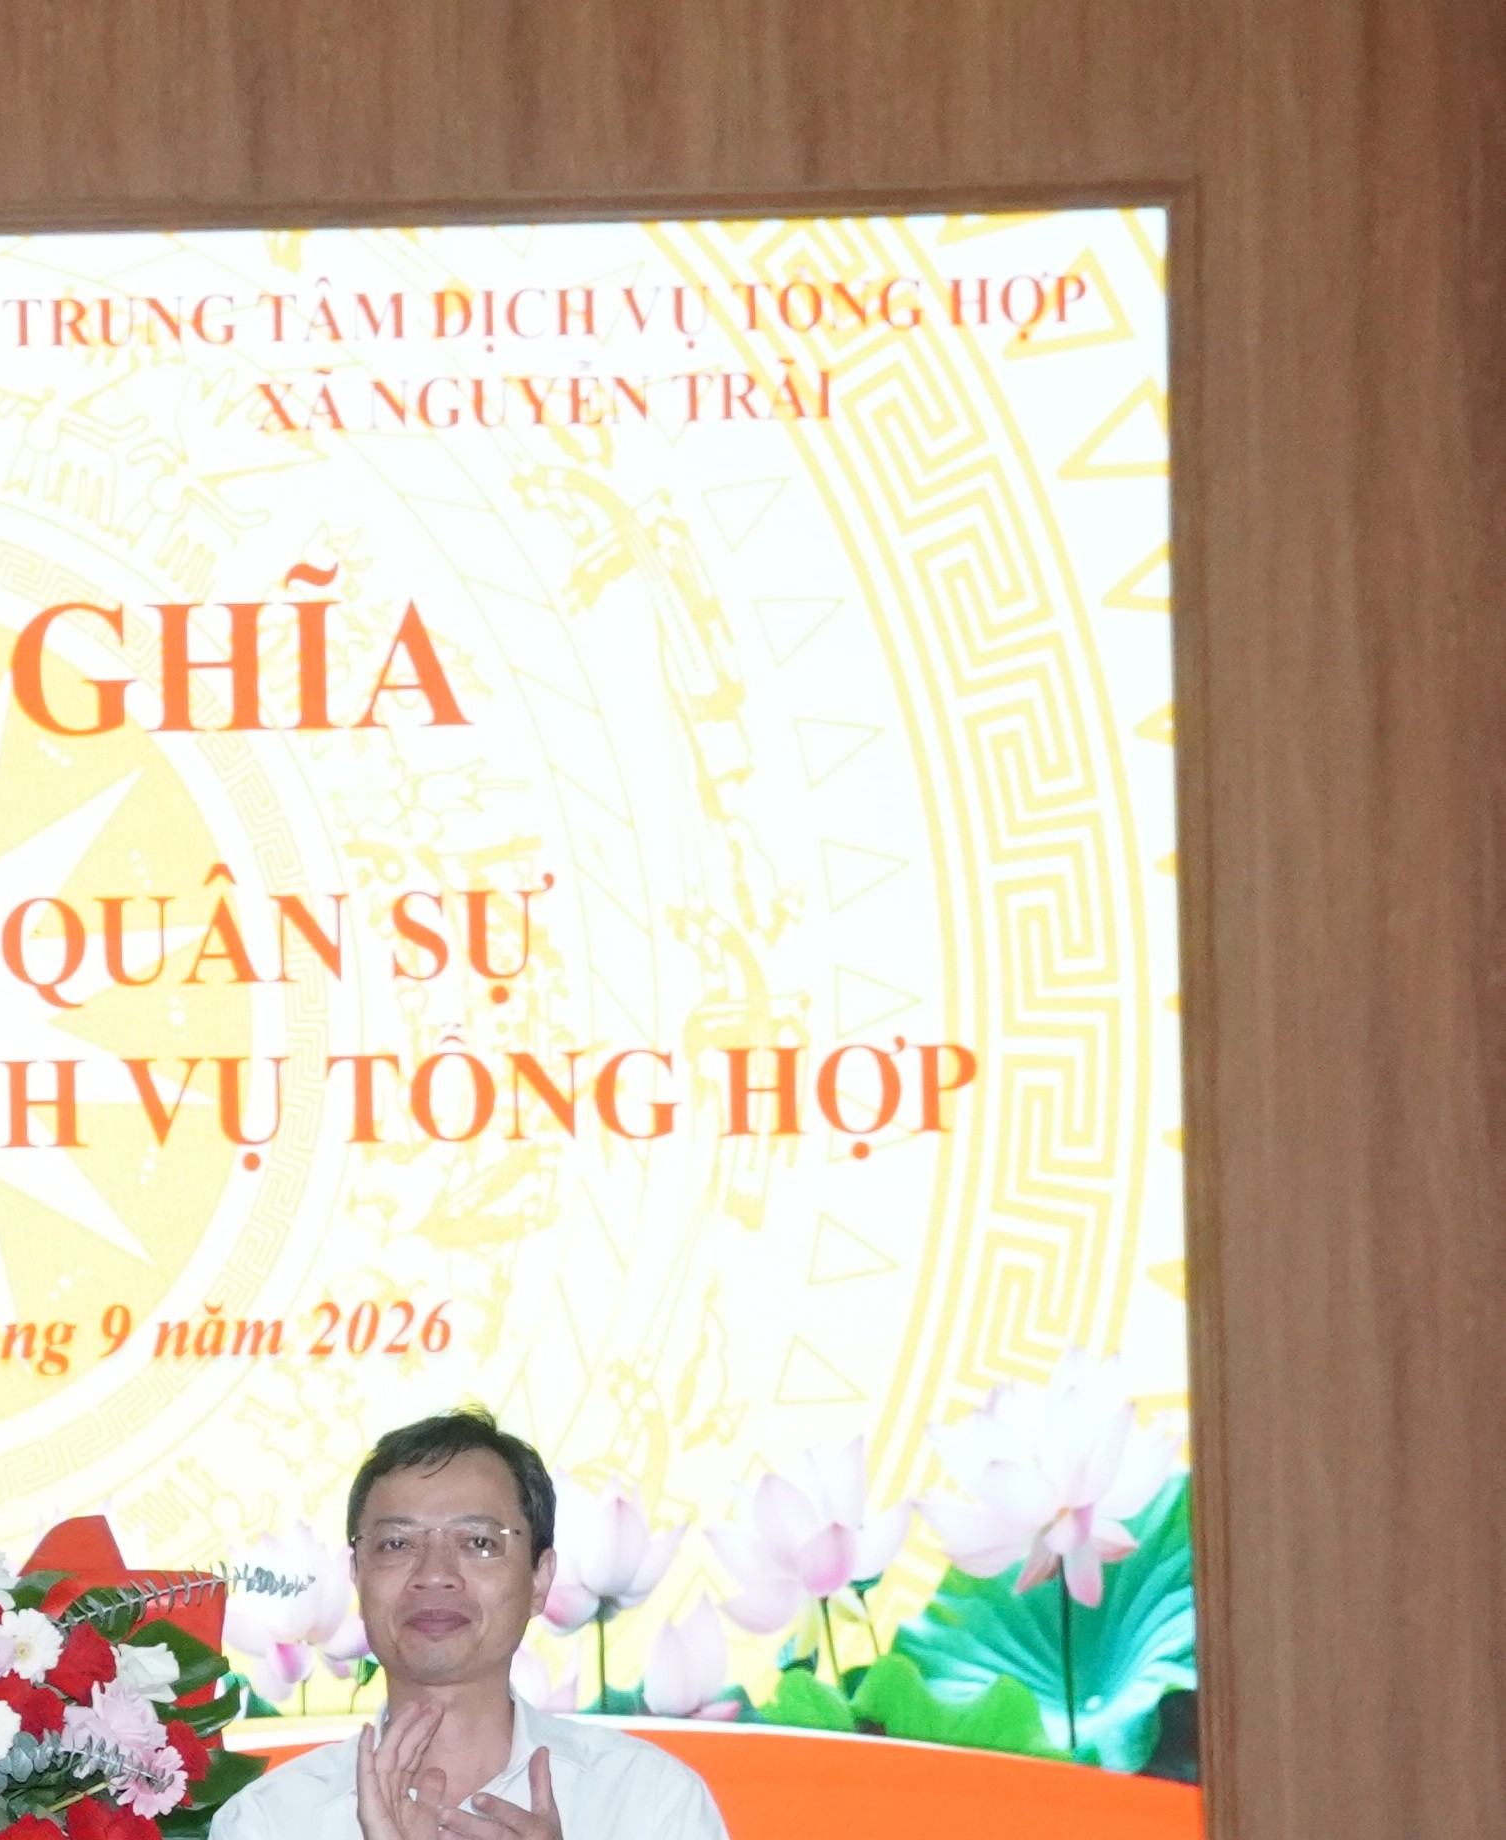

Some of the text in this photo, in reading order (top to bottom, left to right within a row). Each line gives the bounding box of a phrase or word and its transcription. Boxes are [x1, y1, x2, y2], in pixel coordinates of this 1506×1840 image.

[2, 296, 235, 347] TRUNG
[256, 277, 404, 342] TÂM
[433, 288, 595, 353] DỊCH
[622, 286, 708, 350] VỤ
[949, 275, 1087, 342] HỢP
[257, 368, 345, 431] XÃ
[672, 358, 830, 422] TRÃI
[1, 862, 349, 1010] QUÂN
[392, 872, 555, 1005] SỰ
[121, 1056, 288, 1172] VỤ
[725, 1035, 978, 1161] HỢP
[101, 1305, 132, 1357] 9
[153, 1305, 283, 1358] năm
[308, 1300, 451, 1357] 2026
